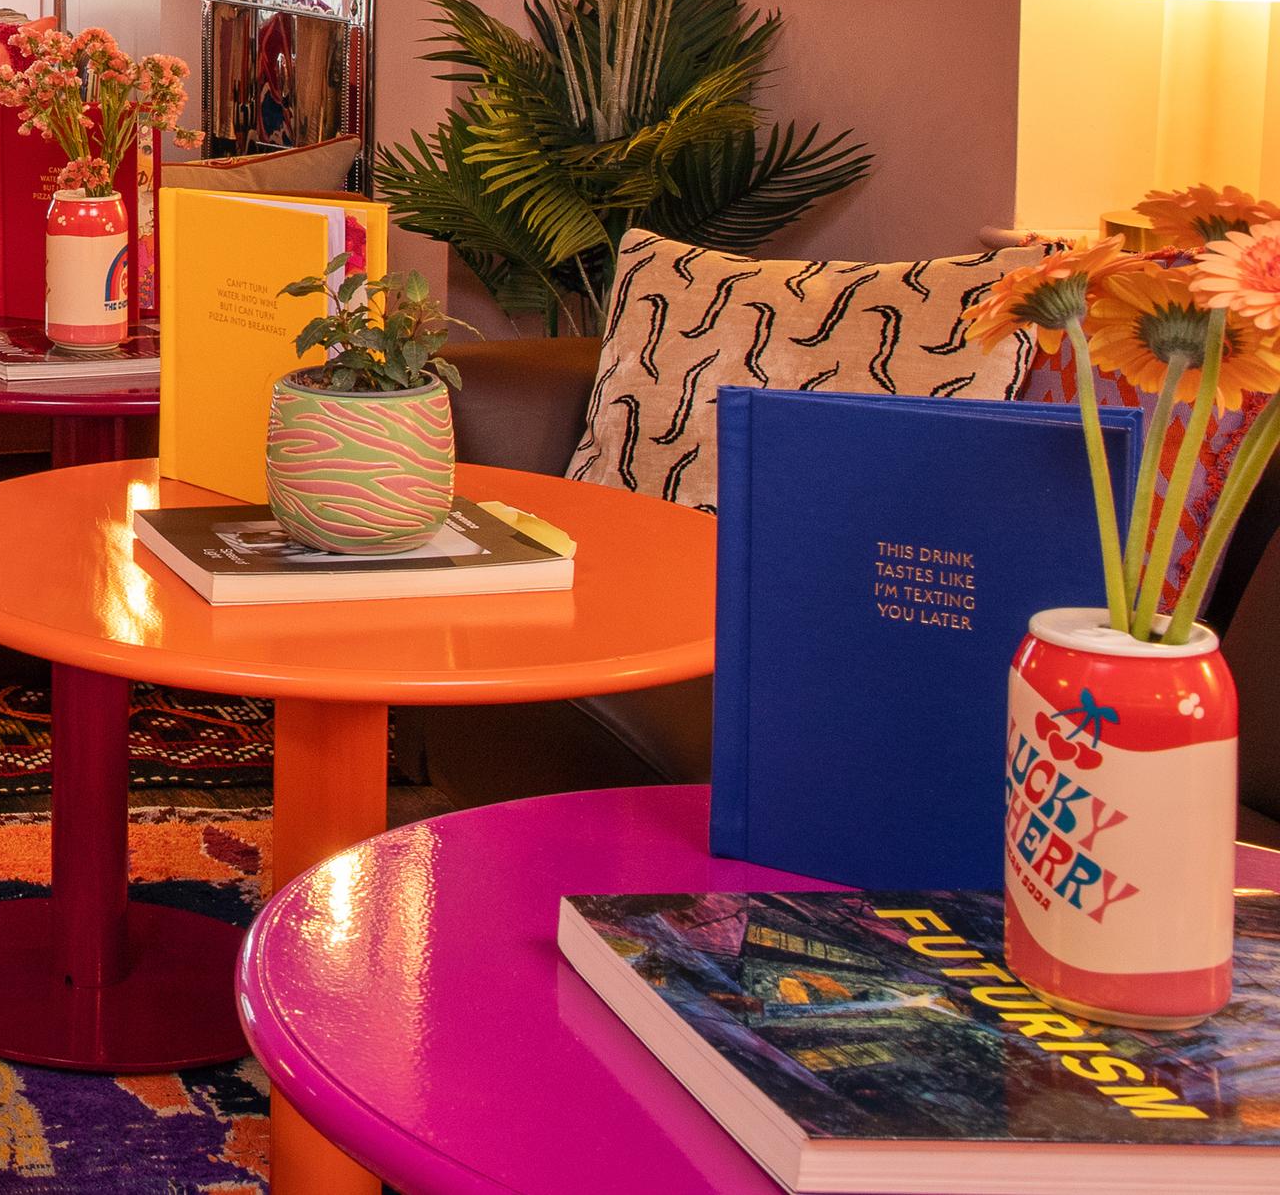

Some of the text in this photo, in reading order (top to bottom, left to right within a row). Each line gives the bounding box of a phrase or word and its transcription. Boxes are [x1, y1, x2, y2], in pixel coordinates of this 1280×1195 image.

[40, 175, 57, 183] WATE
[32, 192, 52, 201] PIZZA
[216, 288, 278, 310] WATER INTO WINE
[226, 278, 268, 294] CAN'T TURN
[104, 302, 117, 311] THE
[220, 302, 232, 311] BUT
[238, 305, 254, 316] CAN
[255, 309, 275, 321] TURN
[208, 311, 287, 337] PIZZA INTO BREAKFAST
[876, 541, 975, 569] THIS DRINK
[875, 561, 975, 590] TASTES LIKE
[874, 582, 976, 610] I'M TEXTING
[877, 602, 973, 631] YOU LATER
[1006, 716, 1129, 852] LUCKY
[1020, 875, 1053, 913] SODA
[874, 908, 1210, 1120] FUTURISM
